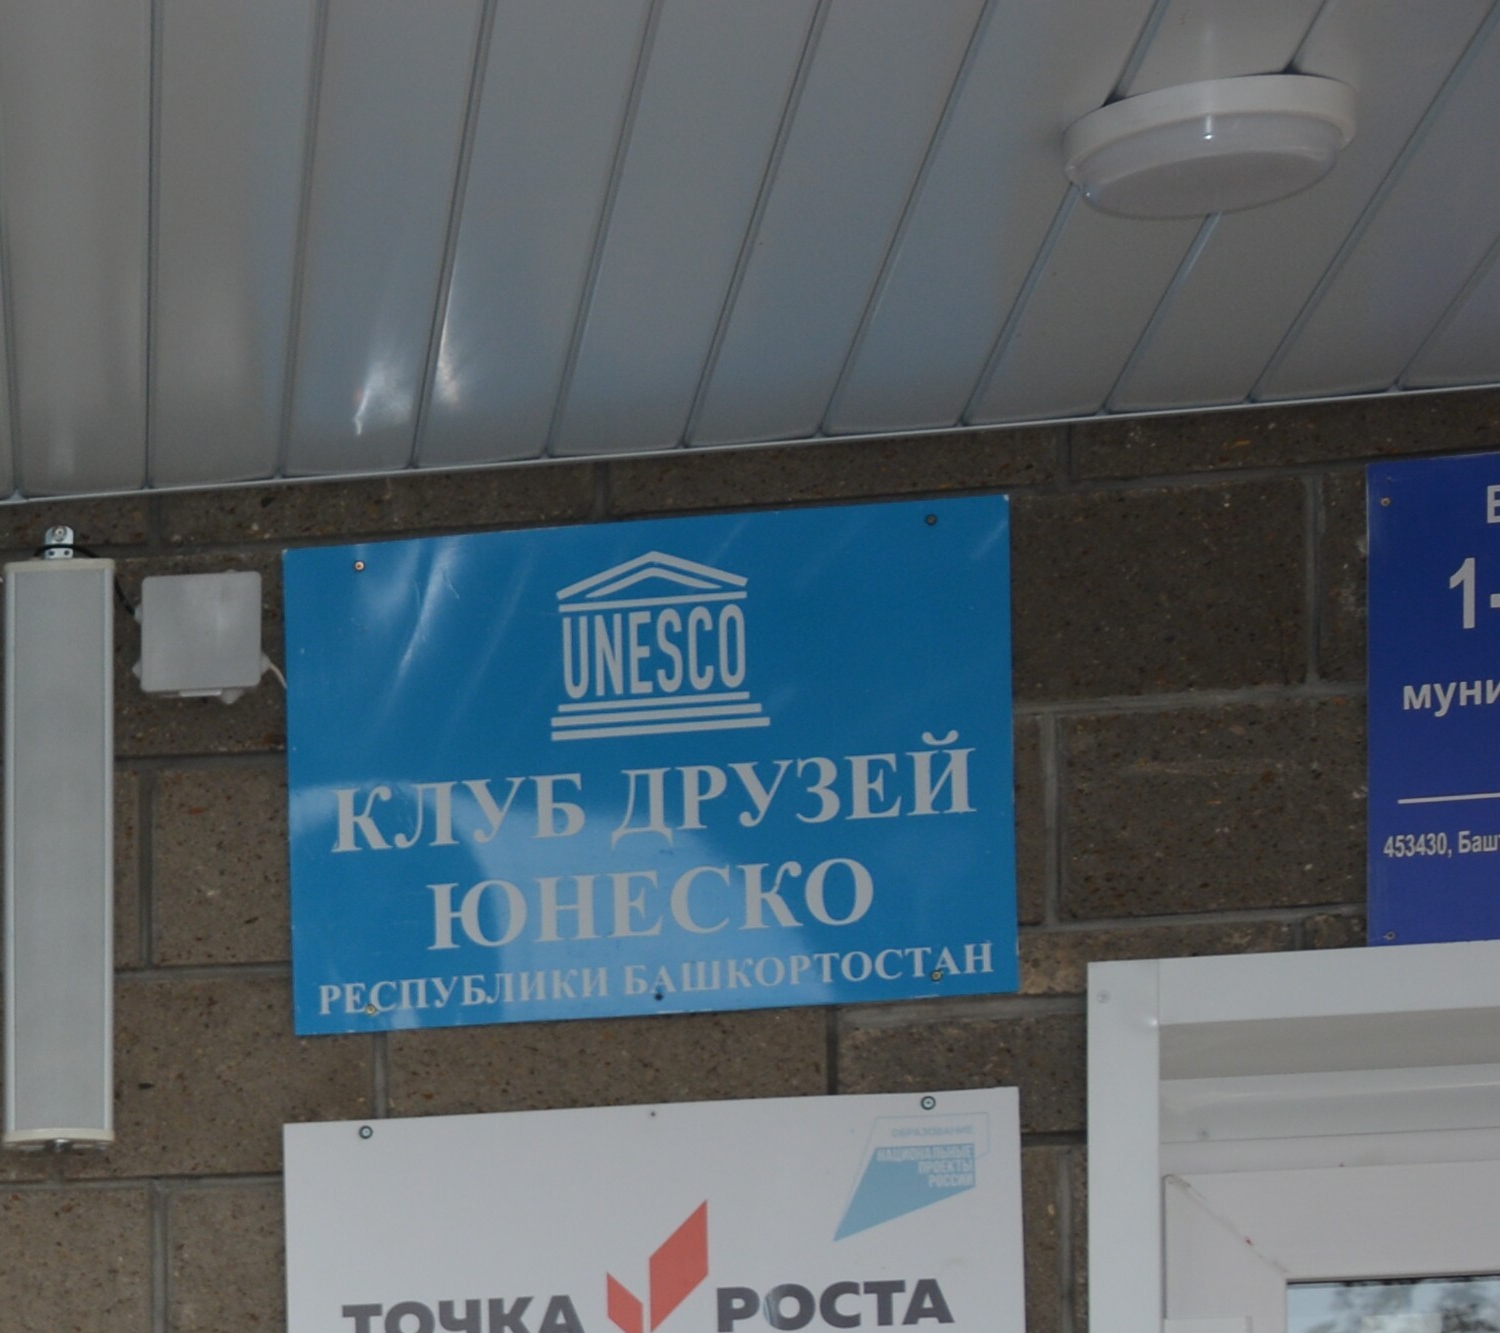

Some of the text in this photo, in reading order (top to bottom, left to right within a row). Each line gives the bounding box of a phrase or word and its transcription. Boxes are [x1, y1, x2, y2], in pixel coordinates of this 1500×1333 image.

[562, 603, 747, 699] UNESCO
[331, 729, 978, 852] КЛУБ ДРУЗЕЙ
[1383, 830, 1500, 858] 453430, Баш
[427, 857, 875, 950] ЮНЕСКО
[319, 942, 994, 1015] РЕСПУБЛИКИ БАШКОРТОСТАН
[716, 1278, 955, 1333] РОСТА
